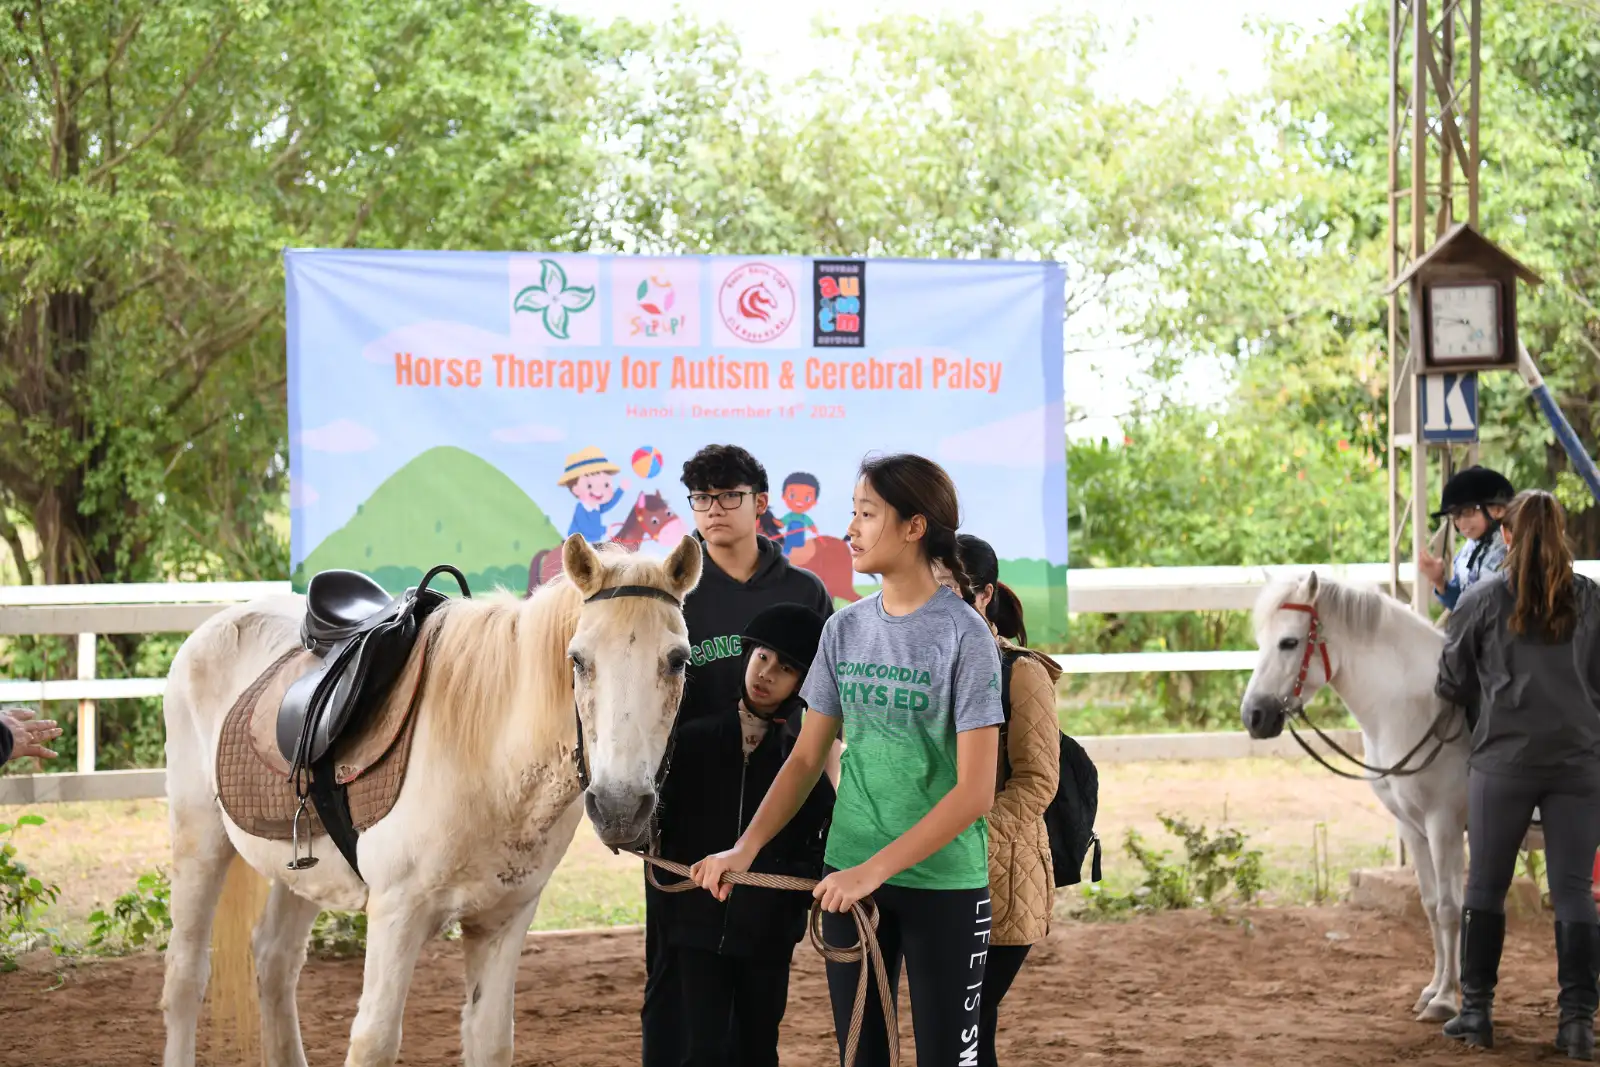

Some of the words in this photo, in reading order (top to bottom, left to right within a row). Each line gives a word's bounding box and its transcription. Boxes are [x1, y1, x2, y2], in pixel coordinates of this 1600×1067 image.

[395, 352, 482, 388] Horse
[492, 353, 611, 394] Therapy
[621, 355, 661, 389] for
[670, 354, 769, 390] Autism
[778, 360, 794, 390] &
[804, 356, 922, 390] Cerebral
[932, 357, 1002, 394] Palsy
[626, 403, 674, 419] Hanoi
[692, 404, 773, 419] December
[810, 404, 846, 420] 2025
[690, 634, 743, 667] CONC
[837, 661, 931, 686] CONCORDIA
[894, 687, 930, 712] ED
[969, 898, 992, 969] LIFE
[964, 981, 981, 1012] IS
